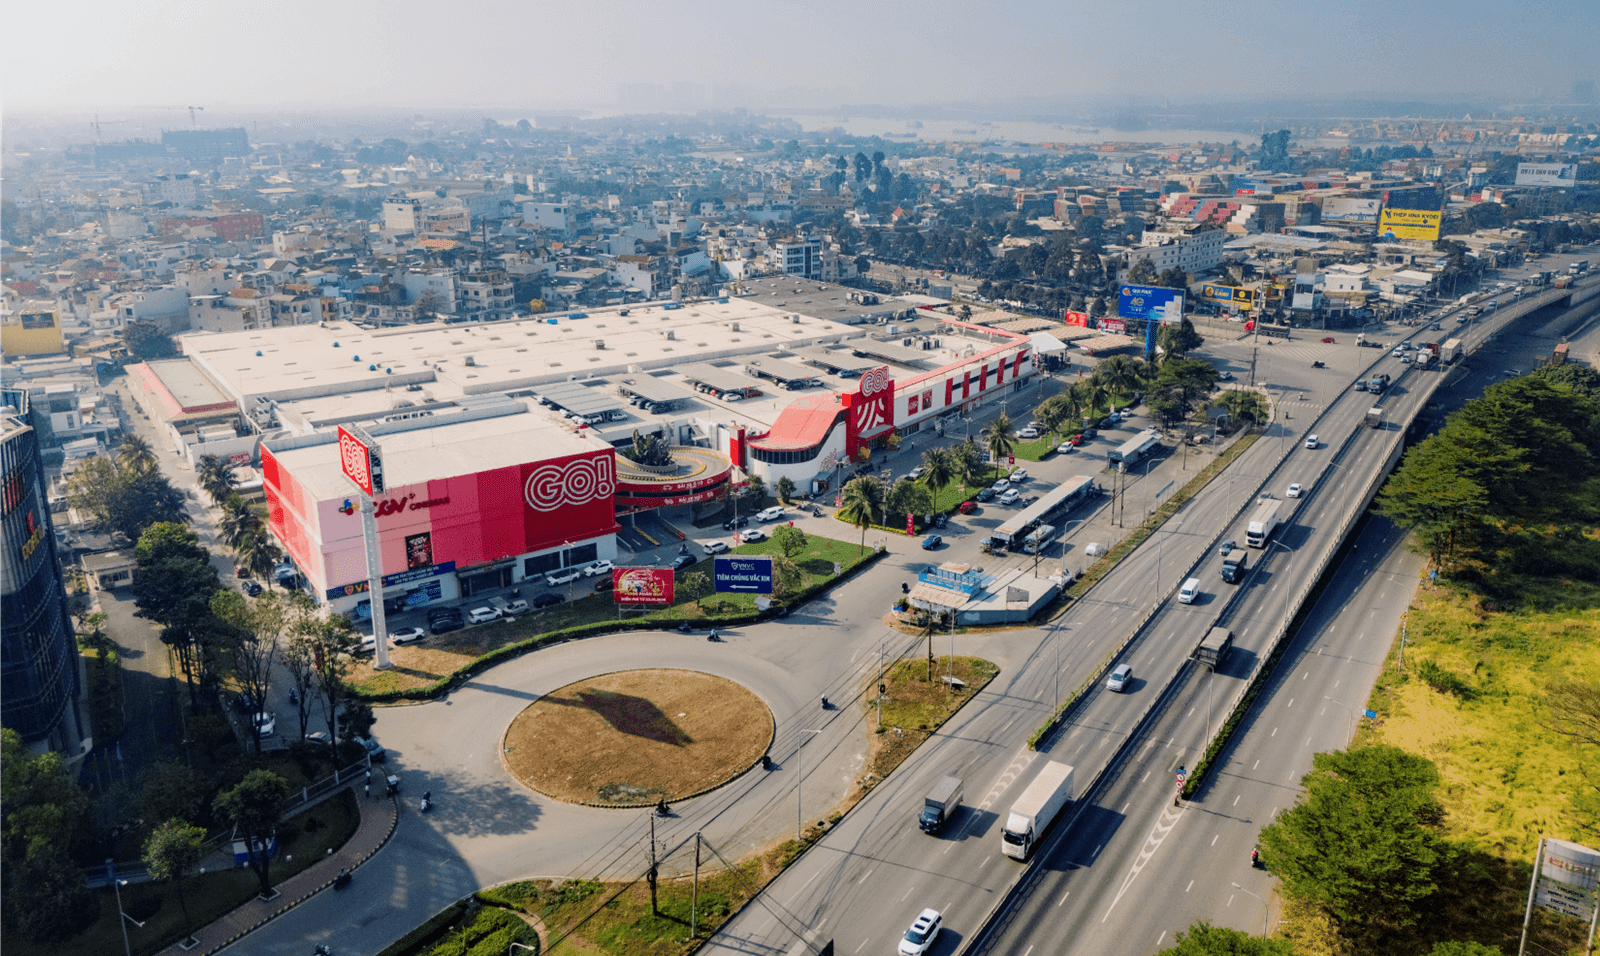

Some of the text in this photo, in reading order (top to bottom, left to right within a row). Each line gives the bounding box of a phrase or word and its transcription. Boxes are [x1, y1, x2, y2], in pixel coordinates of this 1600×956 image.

[862, 366, 889, 397] GO!
[341, 434, 369, 488] GO!
[524, 454, 615, 512] GO!
[731, 573, 749, 581] CHỦNG
